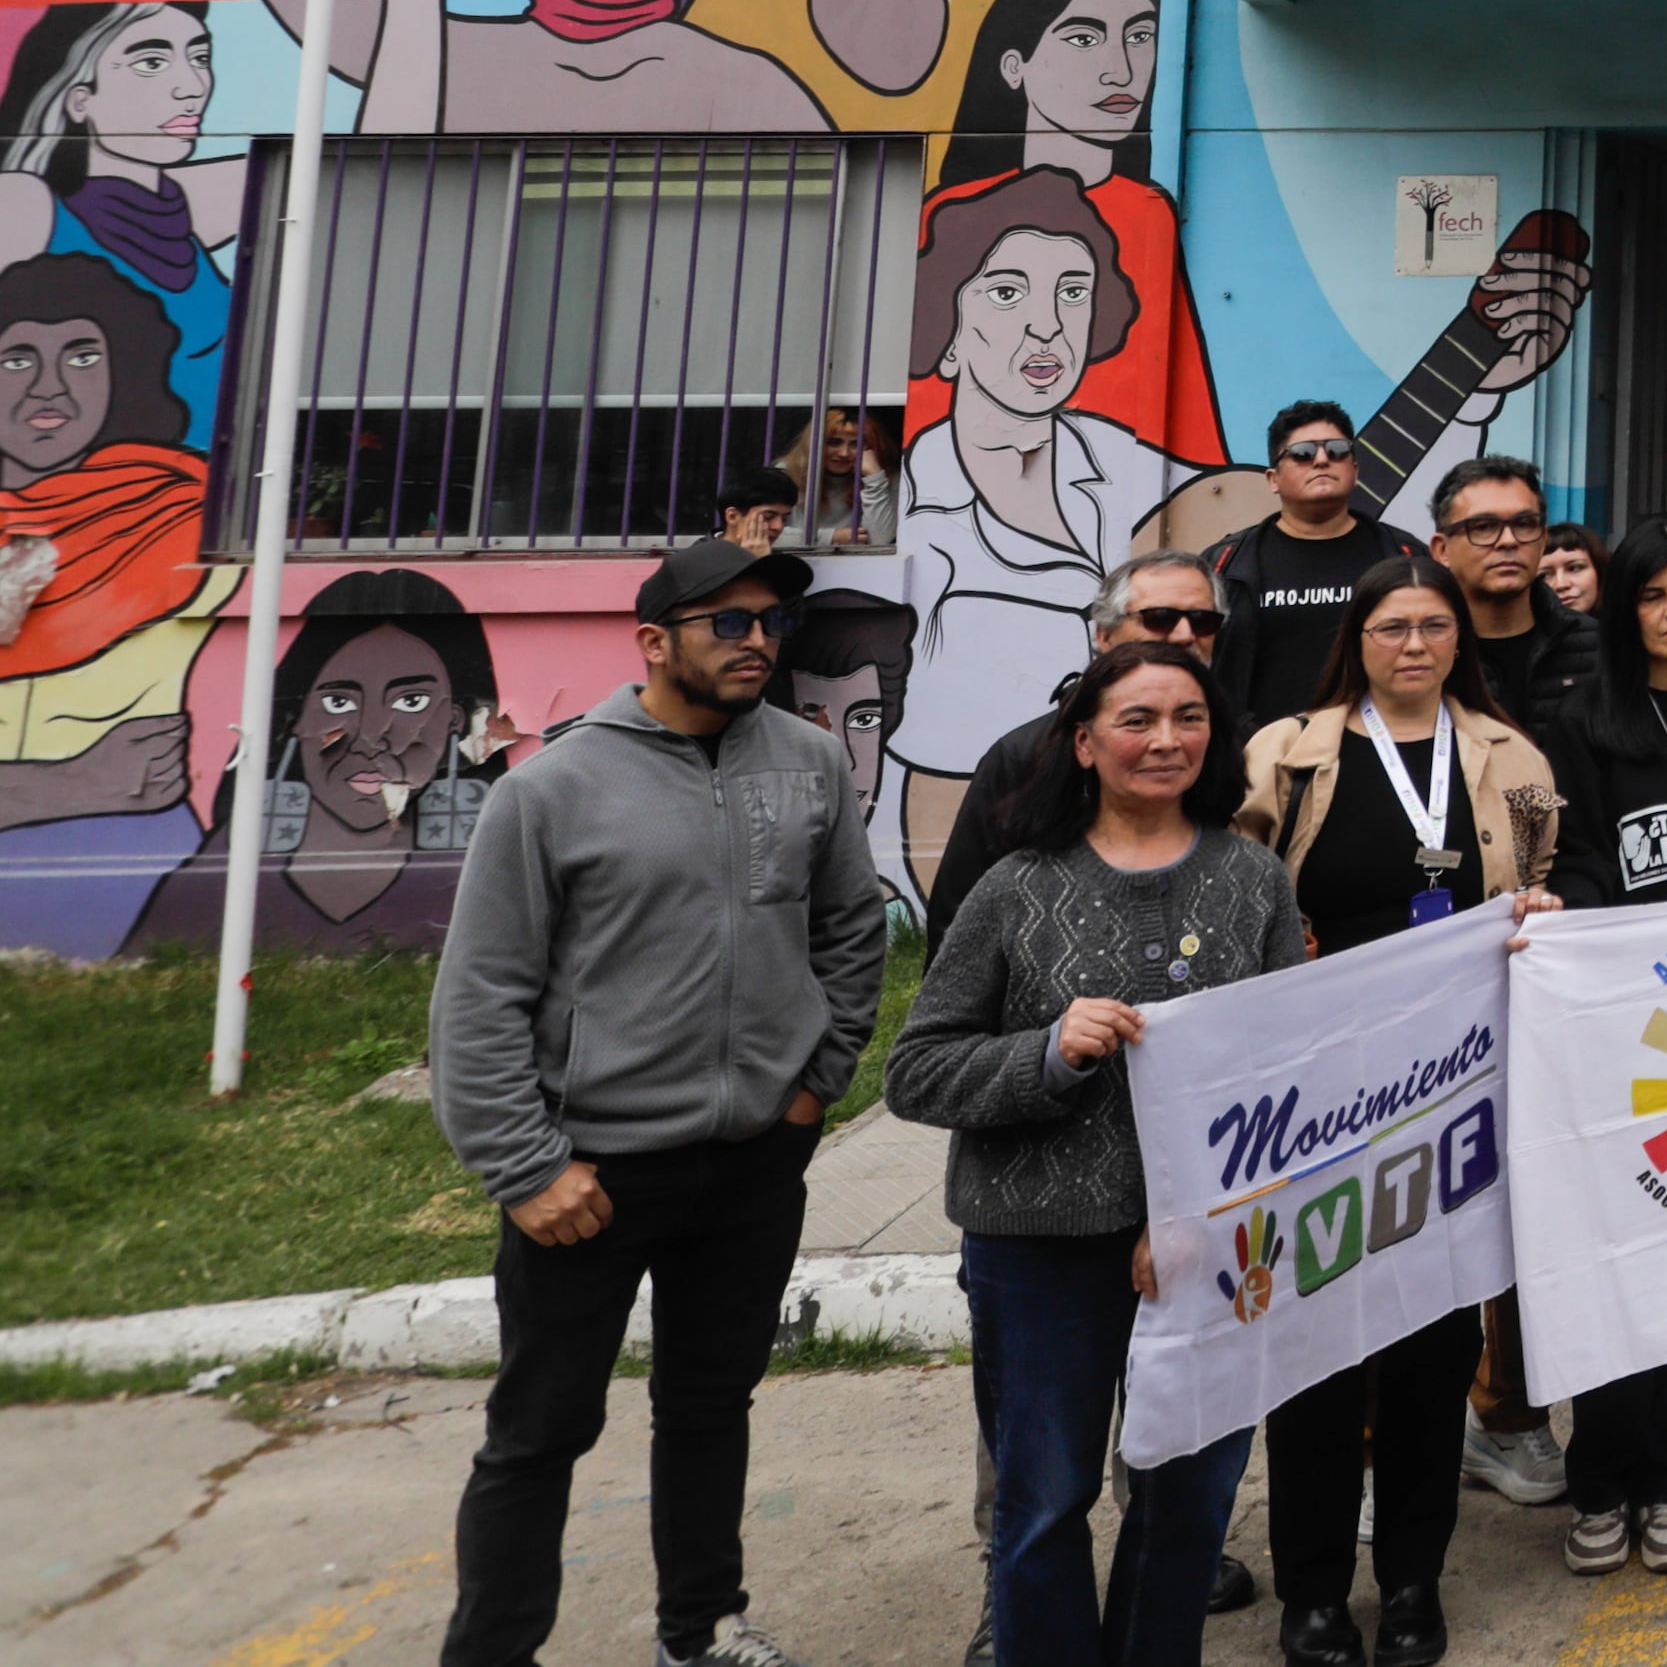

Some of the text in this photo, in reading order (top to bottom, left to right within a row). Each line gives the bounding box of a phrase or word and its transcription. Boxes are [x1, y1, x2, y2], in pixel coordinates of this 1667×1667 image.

[1439, 211, 1484, 232] fech
[1260, 586, 1352, 608] PROJUNJI
[1208, 1023, 1494, 1191] Movimiento
